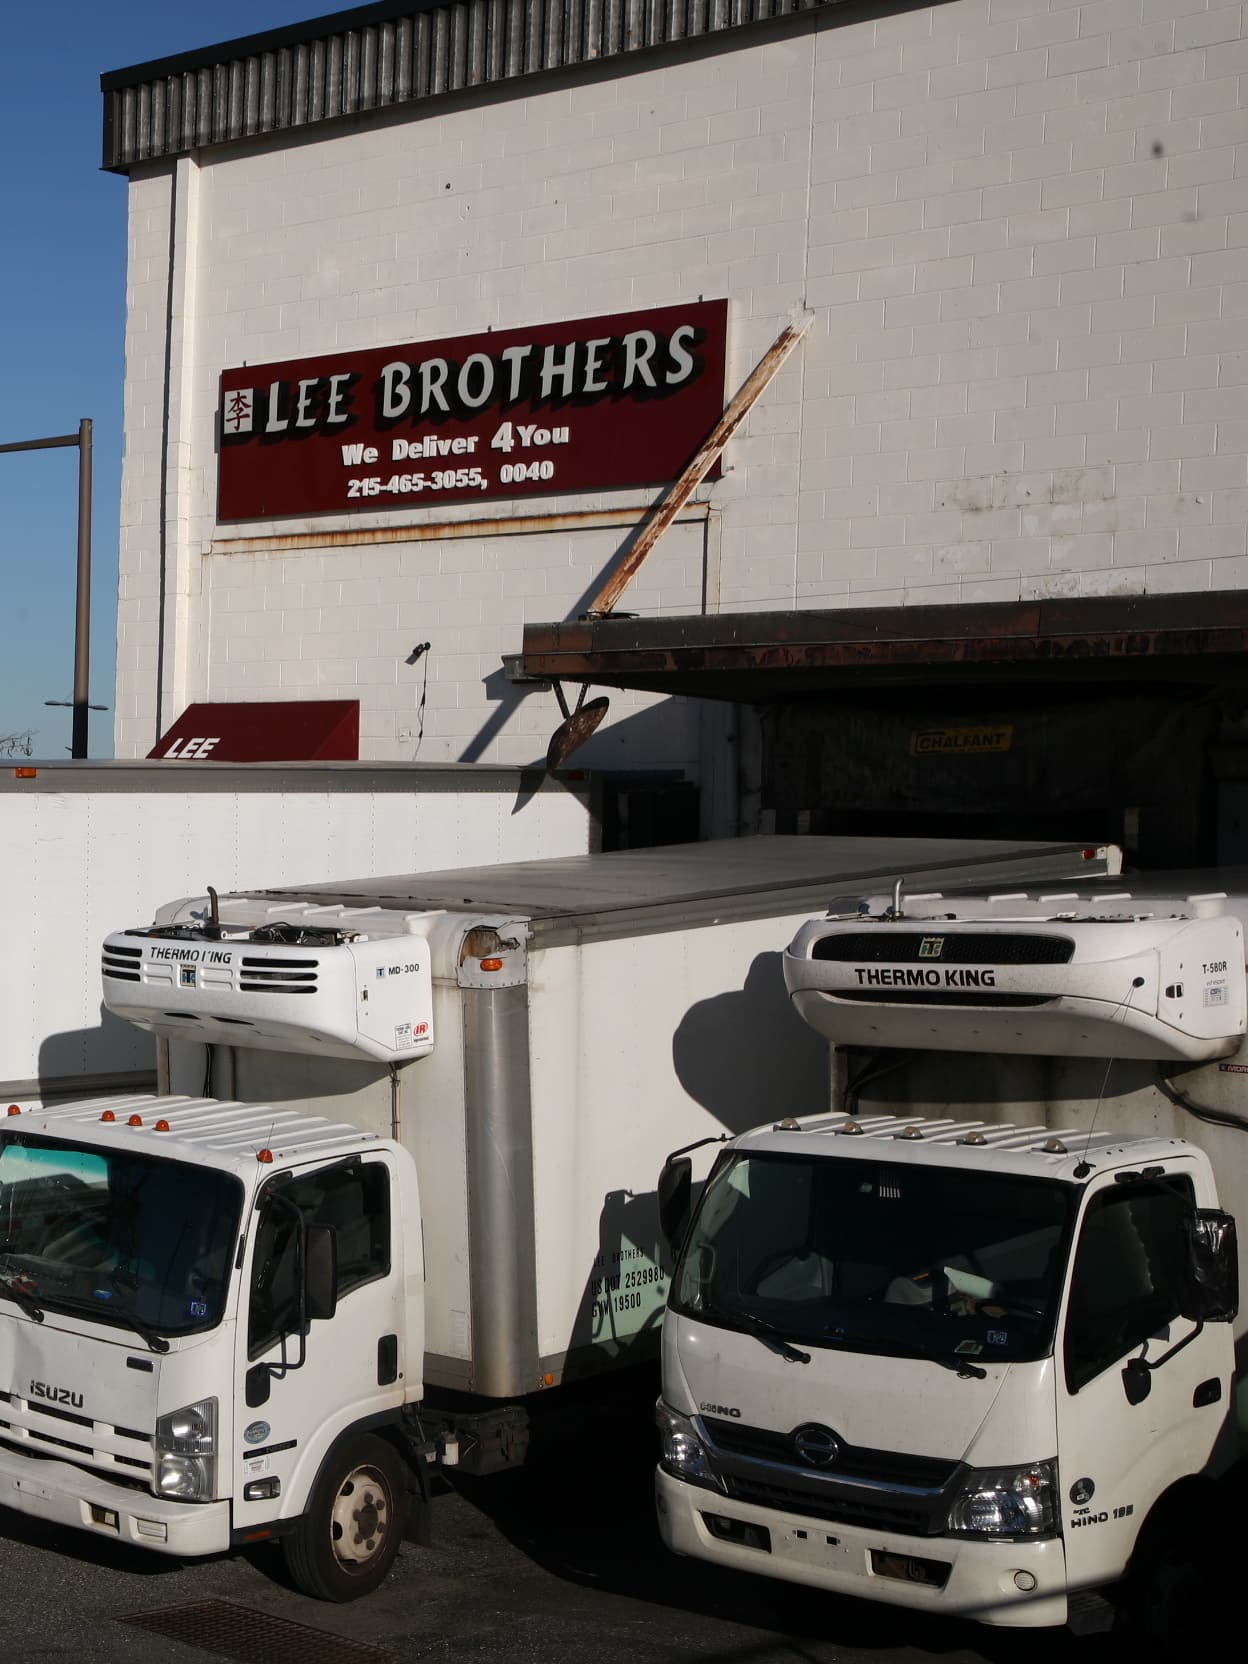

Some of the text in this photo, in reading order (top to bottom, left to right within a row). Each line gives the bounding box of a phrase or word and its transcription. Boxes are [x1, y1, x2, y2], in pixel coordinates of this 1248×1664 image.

[264, 325, 695, 432] LEE BROTHERS
[225, 391, 252, 431] 李
[342, 442, 379, 467] We
[392, 434, 479, 461] Deliver
[347, 460, 554, 498] 215-465-3055, 0040
[163, 737, 221, 759] LEE
[919, 733, 1007, 749] CHALFANT
[150, 946, 200, 962] THERMO
[388, 963, 420, 976] MD-300
[854, 969, 995, 987] THERMO KING
[625, 1265, 665, 1288] 2529980
[615, 1292, 641, 1313] 19500
[30, 1380, 84, 1408] ISUZU
[1071, 1512, 1108, 1528] HINO
